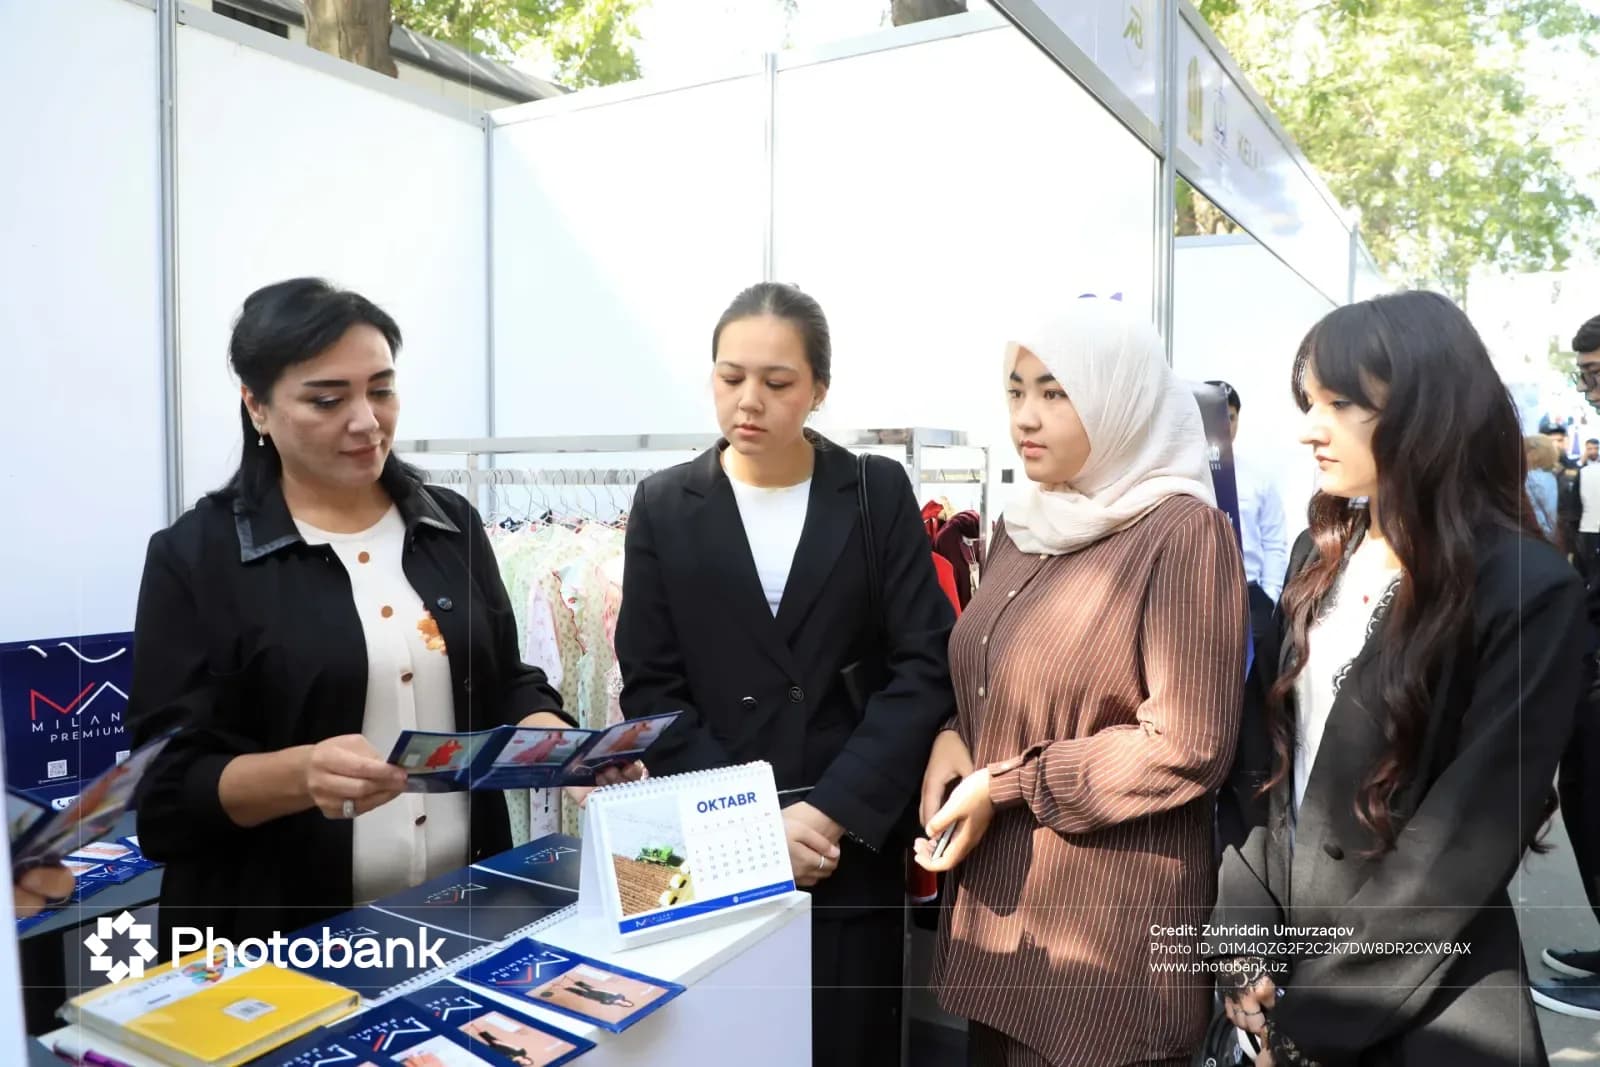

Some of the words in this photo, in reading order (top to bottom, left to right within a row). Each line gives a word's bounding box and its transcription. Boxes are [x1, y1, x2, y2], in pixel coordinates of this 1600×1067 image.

[32, 711, 120, 733] MILAN
[50, 726, 124, 743] PREMIUM
[696, 791, 757, 814] OKTABR
